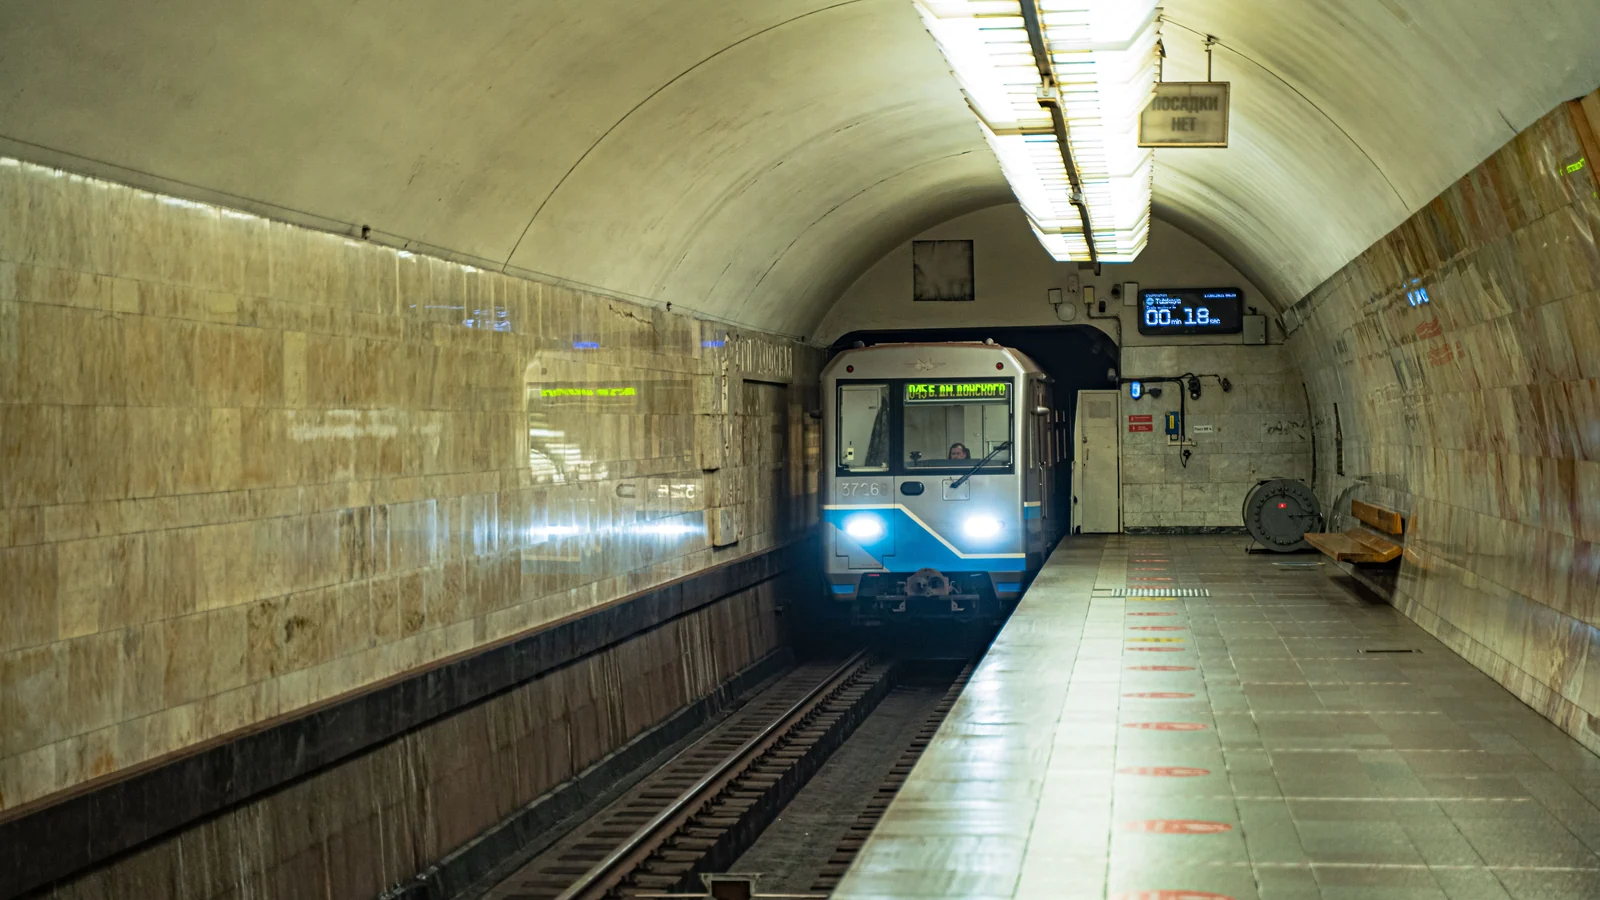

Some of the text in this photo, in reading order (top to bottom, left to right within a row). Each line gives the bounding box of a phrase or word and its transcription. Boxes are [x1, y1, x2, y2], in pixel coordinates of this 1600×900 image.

[1152, 96, 1218, 113] ПОСАДКИ
[1171, 117, 1197, 132] НЕТ
[1145, 309, 1171, 325] 00
[1184, 307, 1209, 325] 18
